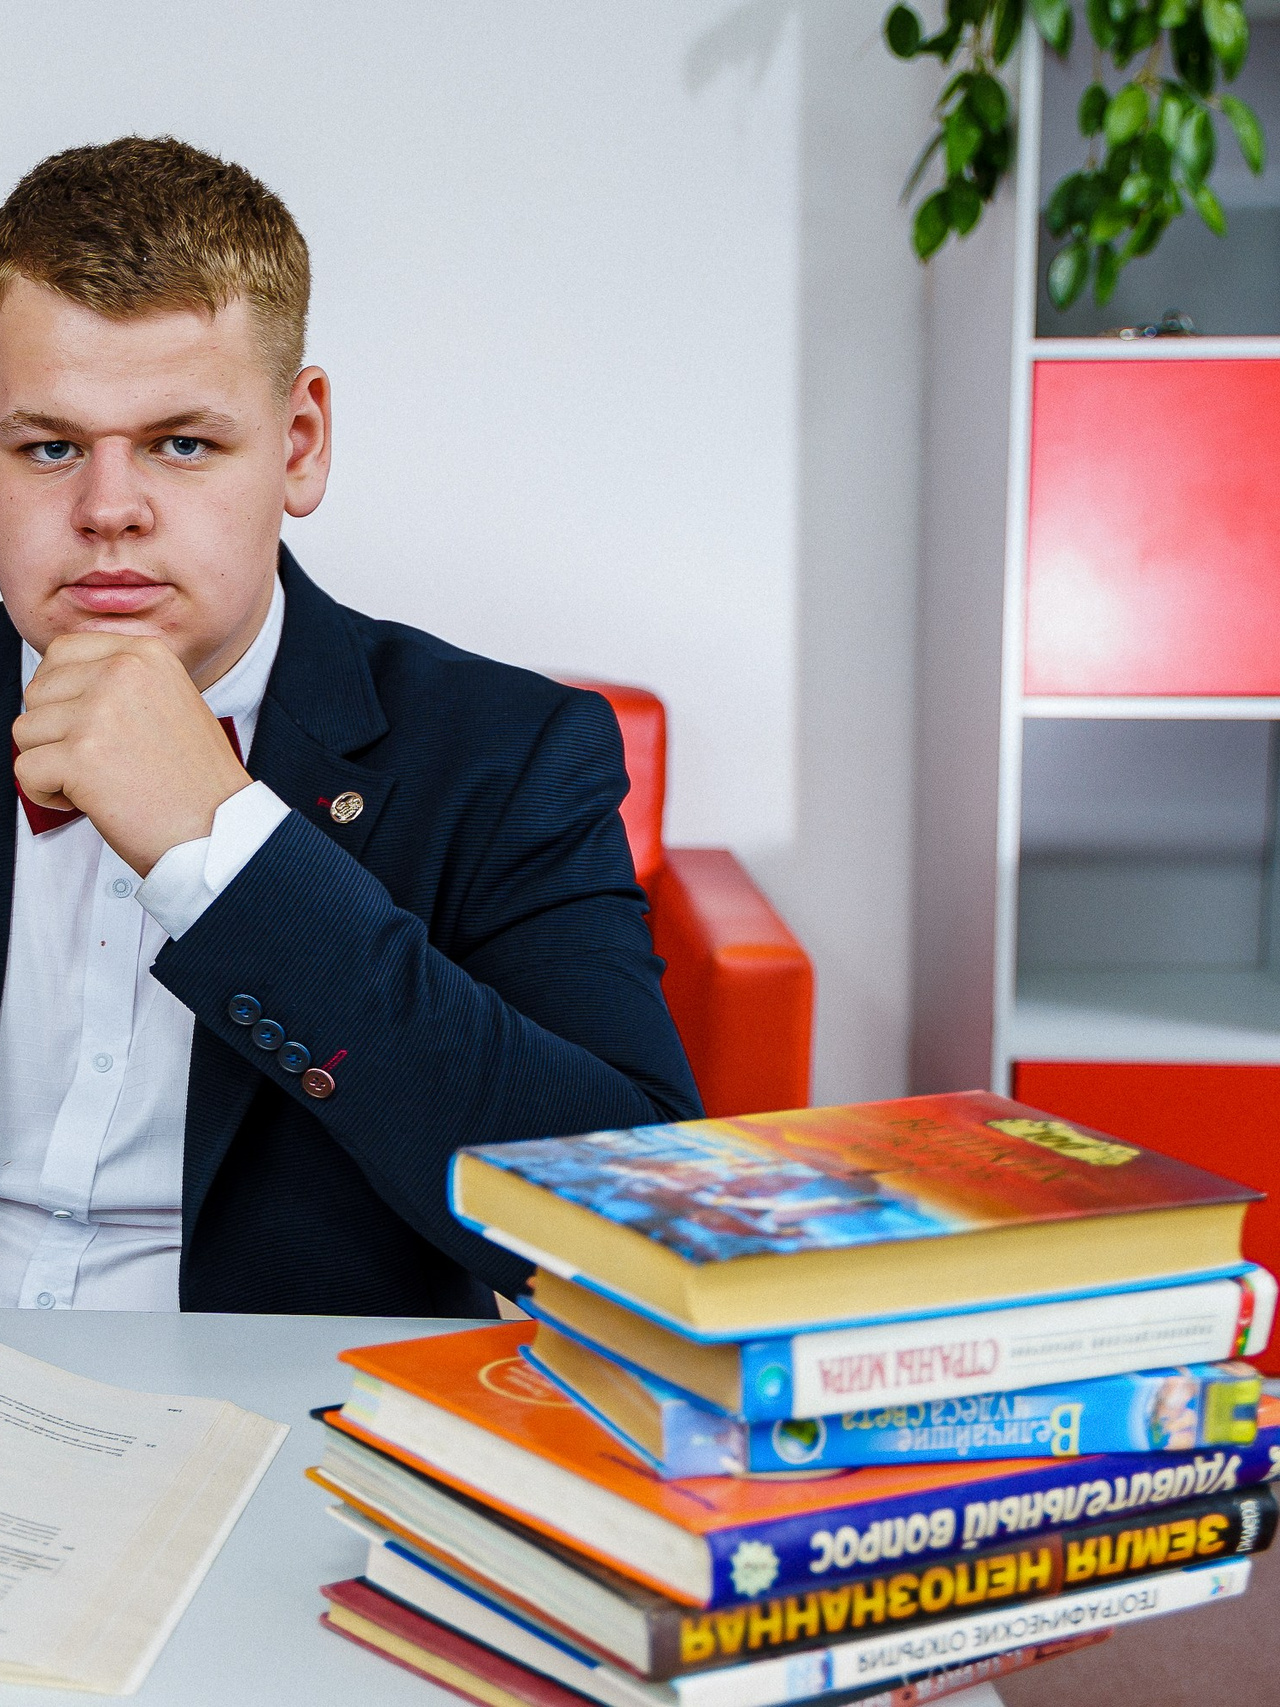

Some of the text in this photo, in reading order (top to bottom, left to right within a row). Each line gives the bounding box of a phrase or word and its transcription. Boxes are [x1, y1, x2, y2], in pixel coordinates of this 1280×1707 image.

[818, 1352, 888, 1394] МИРА
[895, 1338, 1001, 1387] СТРАНЫ
[897, 1402, 1084, 1456] Величайшие
[680, 1513, 1230, 1664] ЗЕМЛЯ НЕПОЗНАННАЯ
[974, 1587, 1159, 1646] ГЕОГРАФИЧЕСКИЕ
[857, 1629, 968, 1673] ОТКРЫТИЯ
